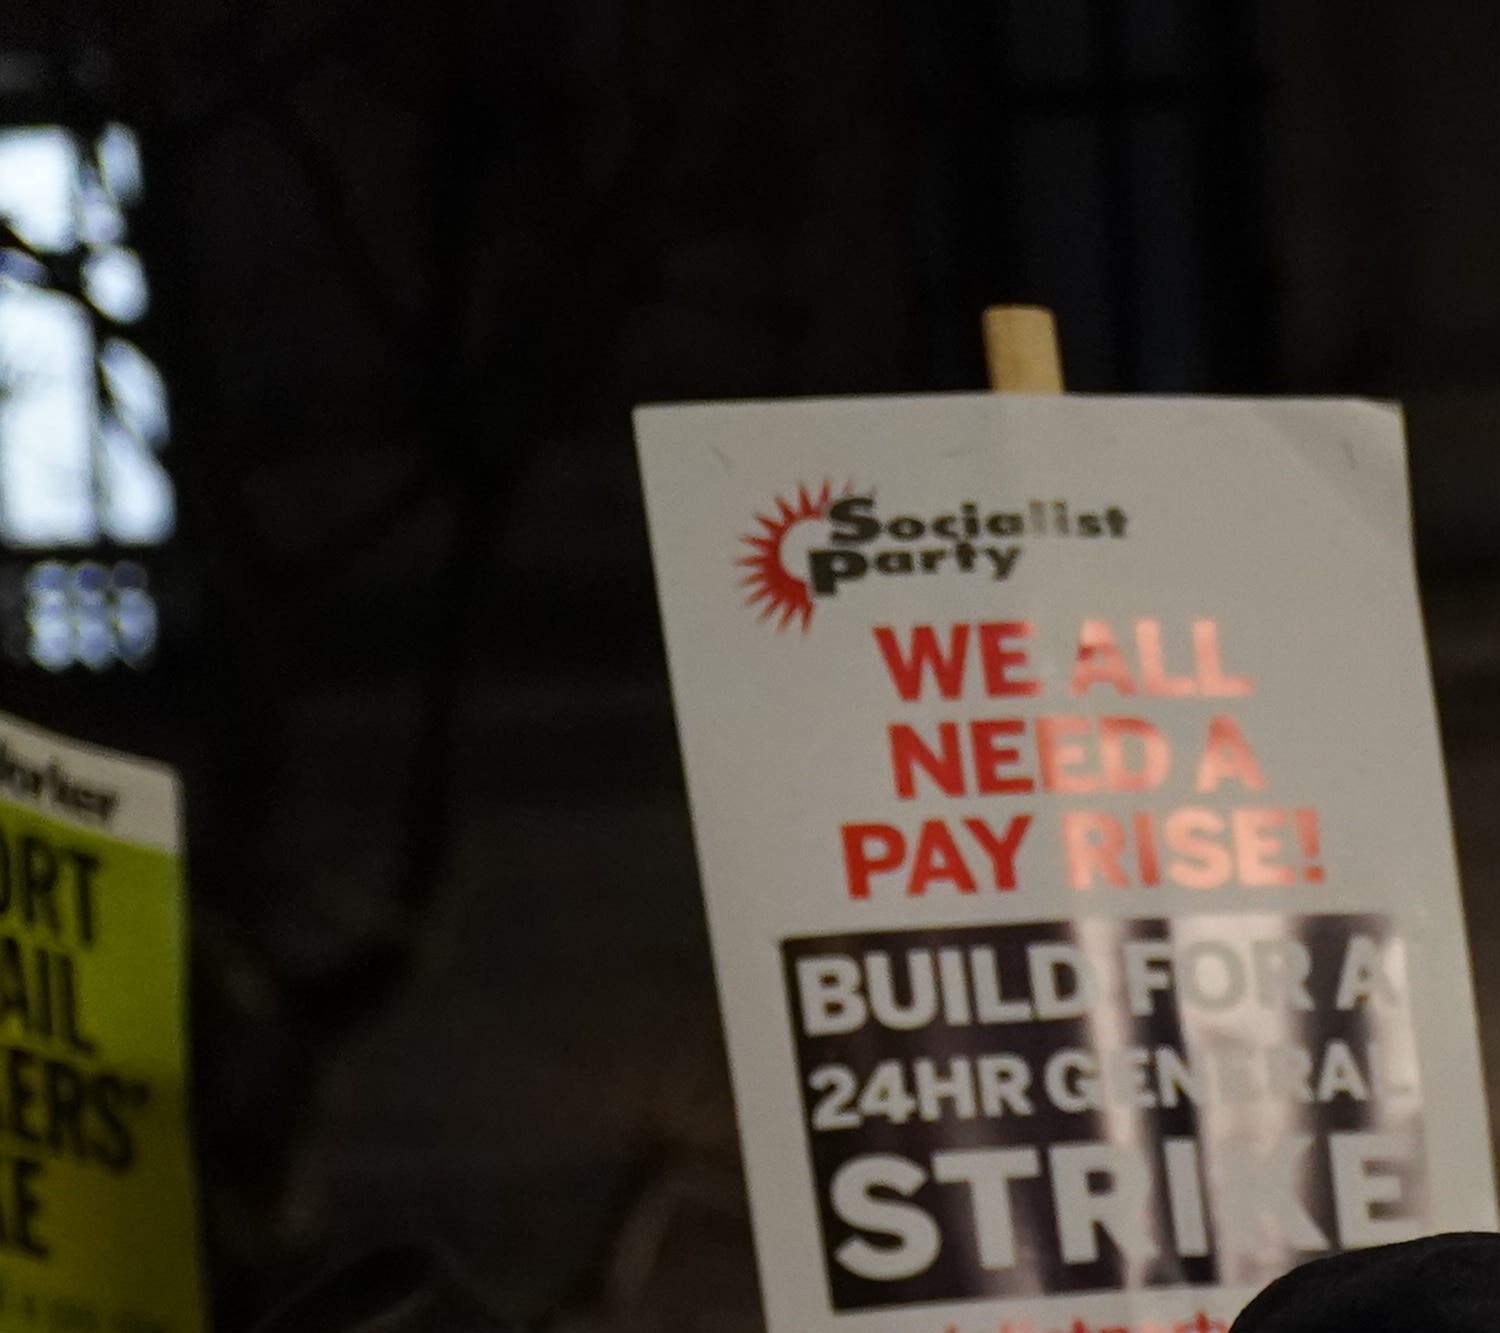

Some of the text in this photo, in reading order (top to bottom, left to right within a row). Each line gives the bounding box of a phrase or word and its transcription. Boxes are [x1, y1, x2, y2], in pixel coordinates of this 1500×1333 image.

[826, 492, 1129, 546] Socialist
[873, 618, 1256, 704] WE ALL
[0, 740, 119, 822] orker
[887, 713, 1268, 801] NEED A
[840, 807, 1327, 902] PAY RISE!
[797, 936, 1404, 1037] BUILD FOR A
[808, 1038, 1418, 1131] 24HR GENERAL
[830, 1132, 1402, 1283] STRIKE
